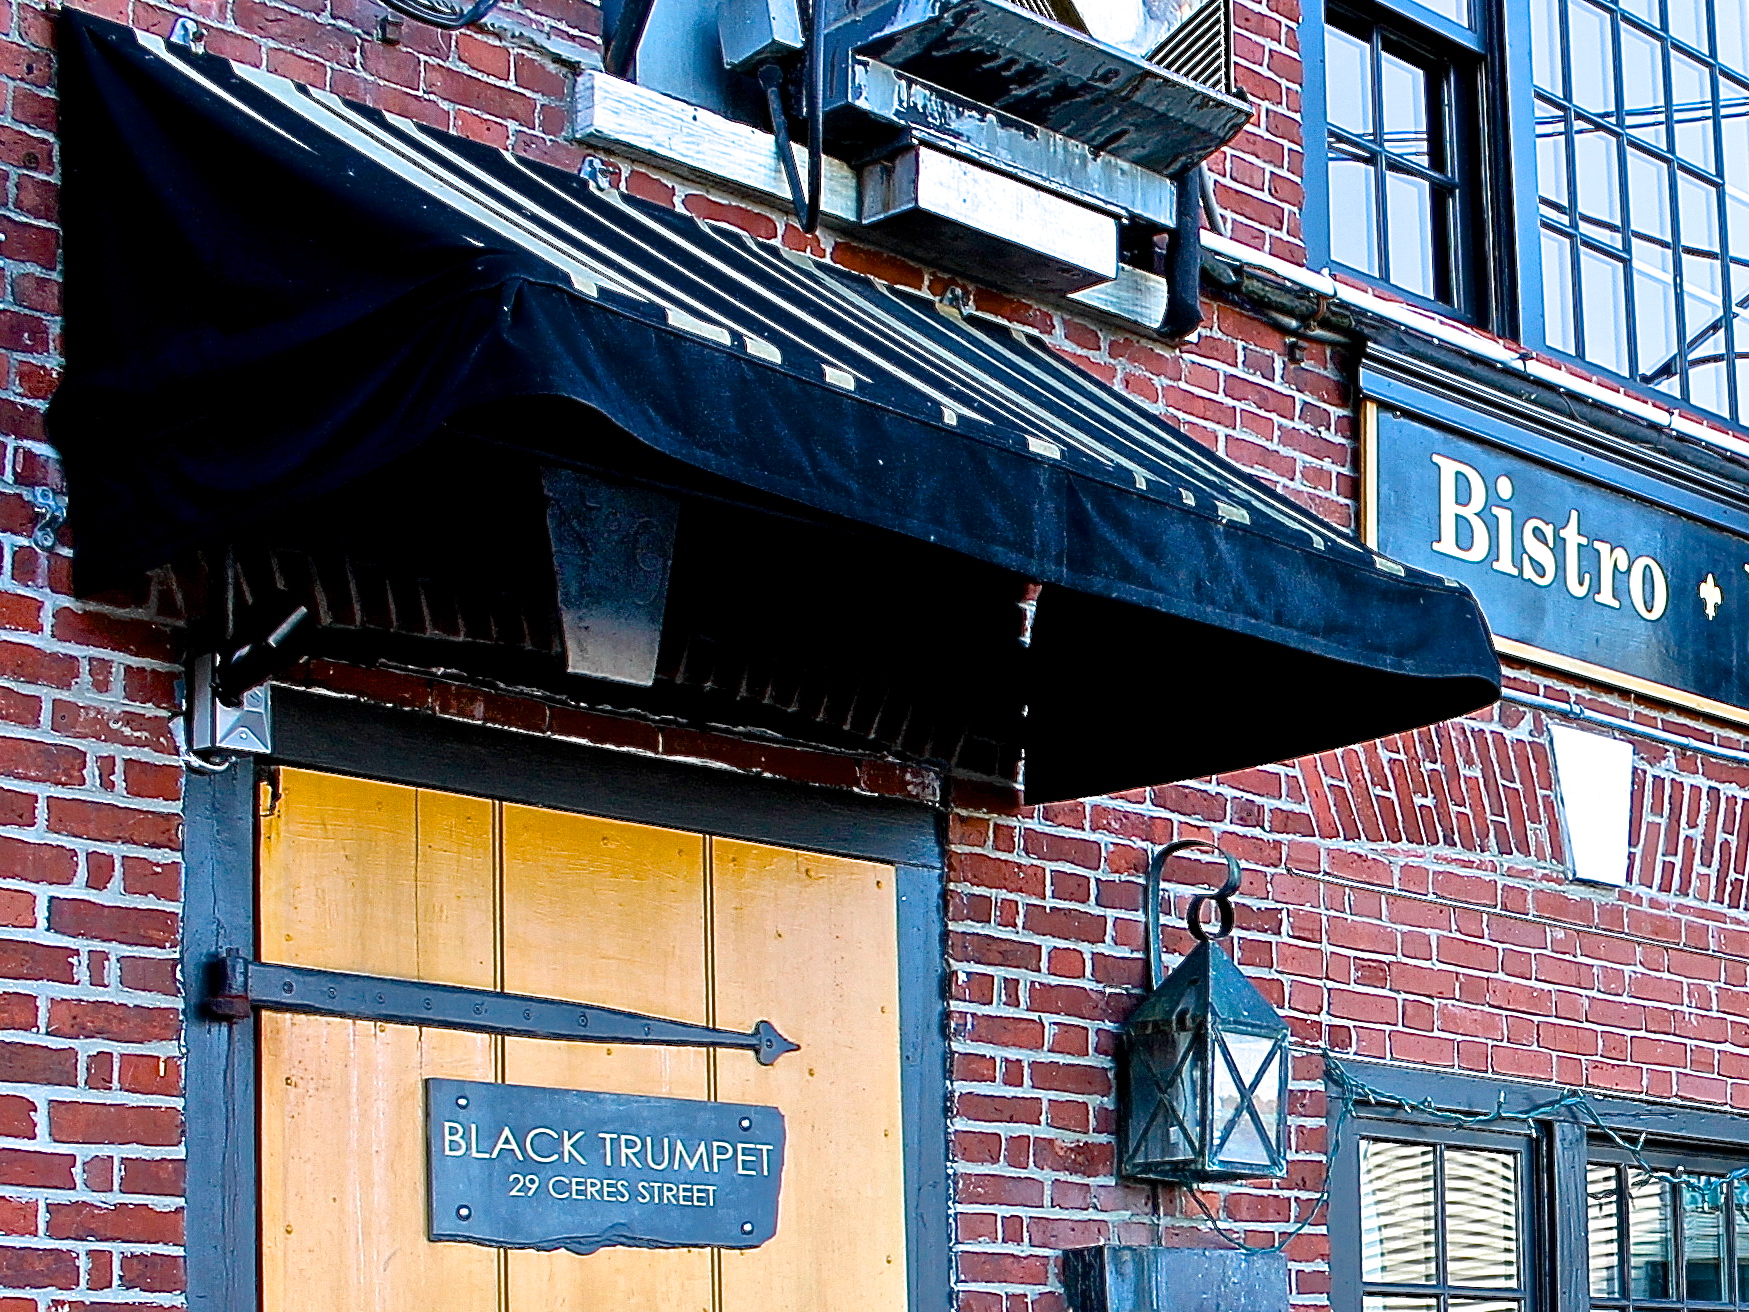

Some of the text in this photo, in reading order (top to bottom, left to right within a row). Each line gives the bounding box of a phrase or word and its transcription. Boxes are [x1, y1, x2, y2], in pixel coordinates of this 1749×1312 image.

[1431, 453, 1668, 622] Bistro
[443, 1122, 774, 1177] BLACK TRUMPET
[508, 1173, 717, 1207] 29 CERES STREET
